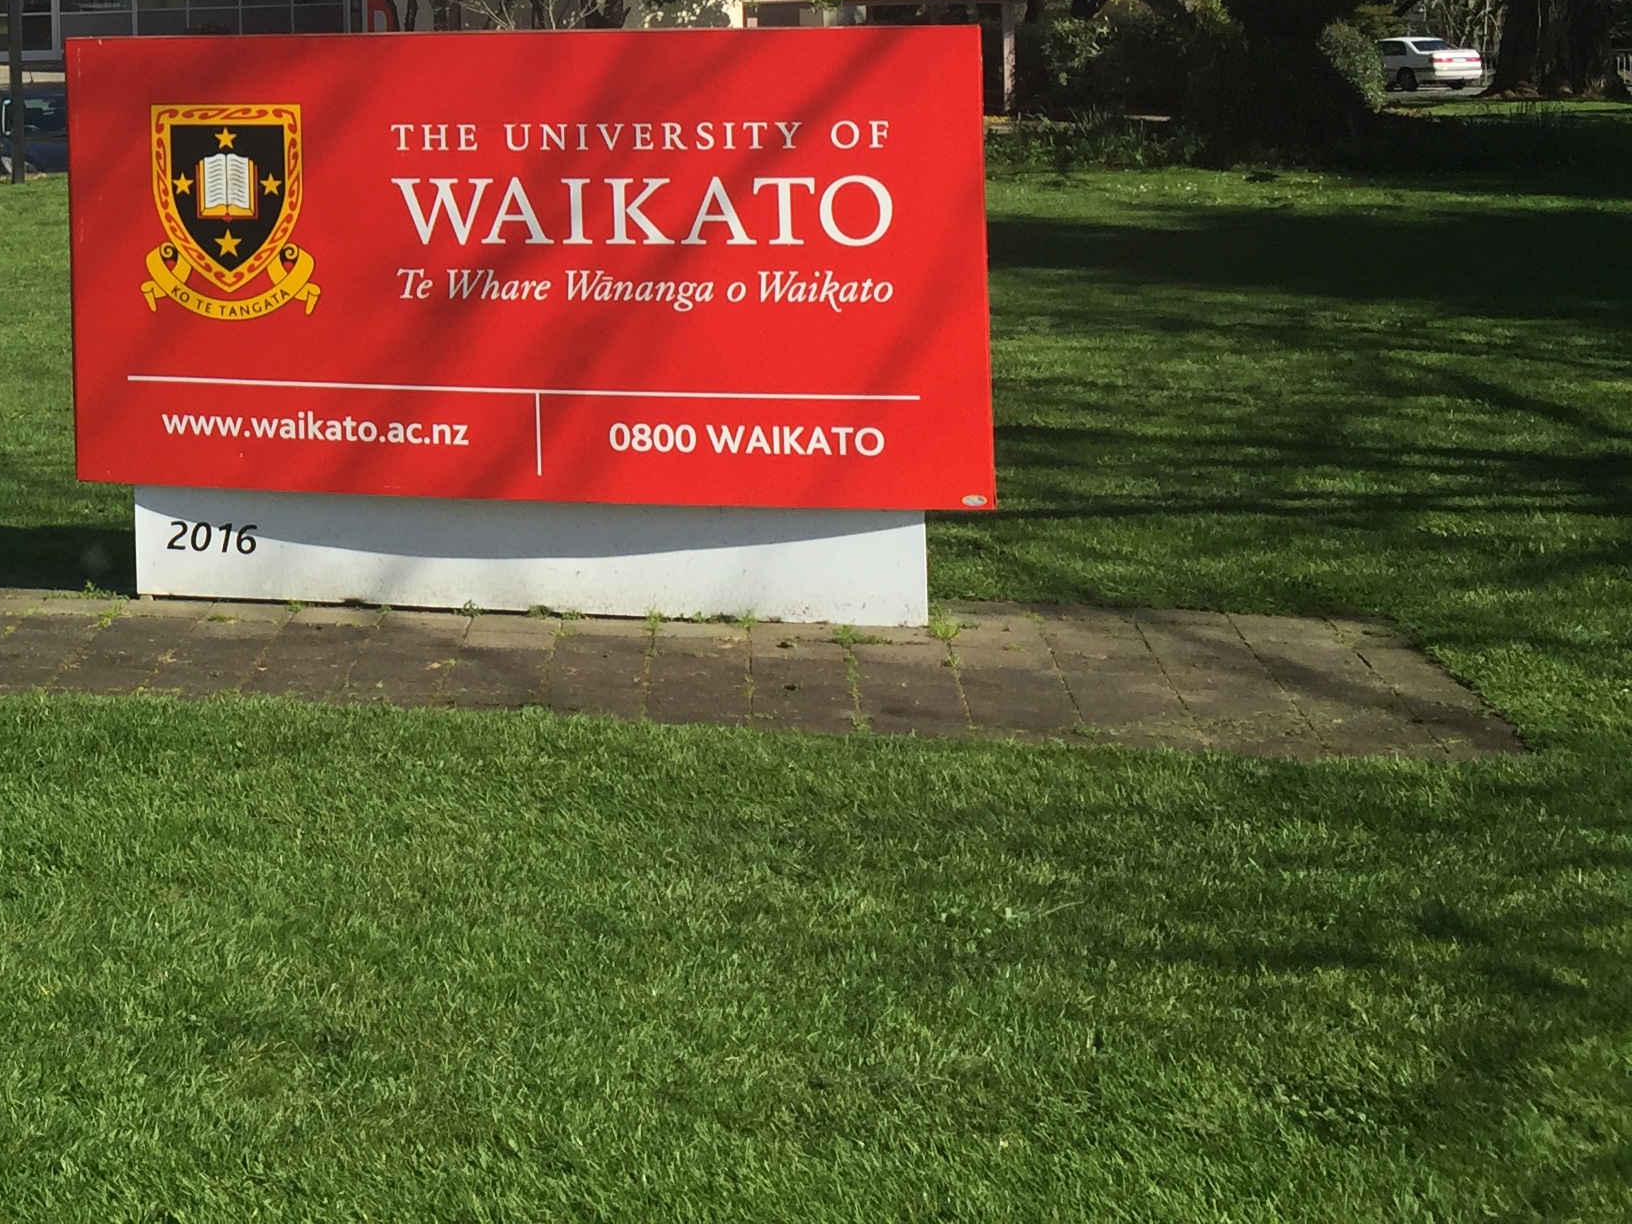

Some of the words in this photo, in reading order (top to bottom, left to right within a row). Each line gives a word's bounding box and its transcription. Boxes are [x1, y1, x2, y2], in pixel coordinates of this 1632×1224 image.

[391, 124, 478, 151] THE
[503, 121, 802, 151] UNIVERSITY
[830, 120, 889, 149] OF
[391, 175, 894, 246] WAIKATO
[171, 285, 190, 303] KO
[196, 298, 212, 313] TE
[219, 288, 291, 317] TANGATA
[397, 269, 433, 299] Te
[447, 270, 552, 301] Whare
[566, 271, 714, 312] Wānanga
[726, 281, 747, 303] o
[758, 271, 894, 312] Waikato
[161, 411, 470, 446] www.waikato.ac.nz
[609, 422, 697, 454] 0800
[706, 424, 885, 457] WAIKATO
[166, 520, 259, 554] 2016
